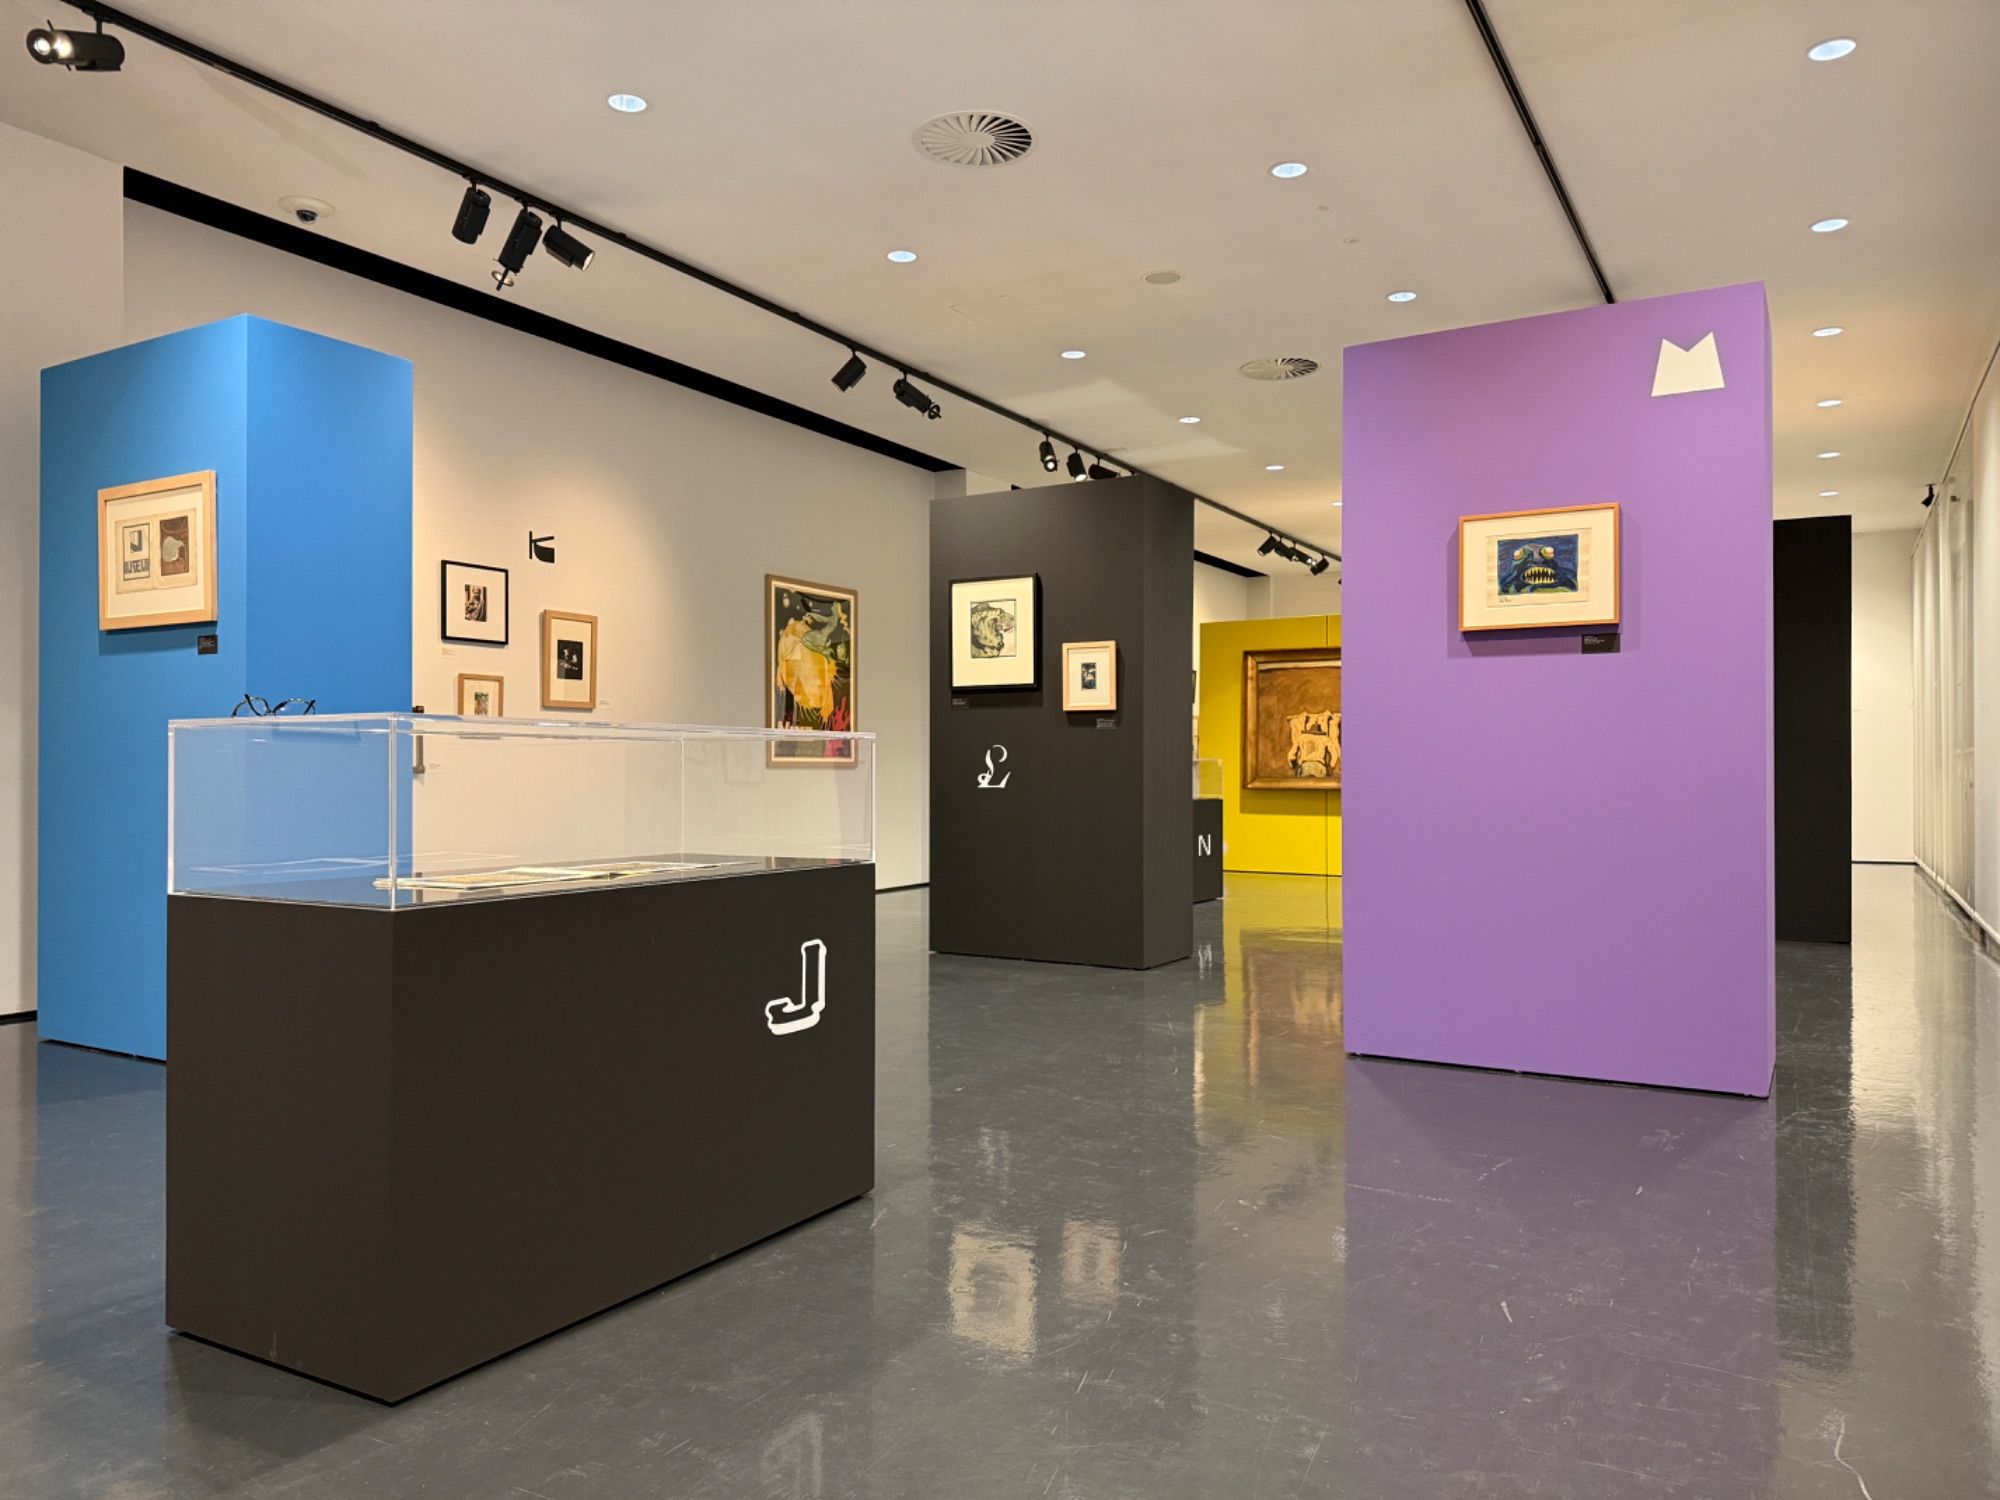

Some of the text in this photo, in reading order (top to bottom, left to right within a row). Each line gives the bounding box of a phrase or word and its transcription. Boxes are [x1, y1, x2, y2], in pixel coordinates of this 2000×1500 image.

[1651, 331, 1725, 397] M
[529, 531, 555, 563] K
[1198, 833, 1211, 856] N
[765, 938, 827, 1036] J
